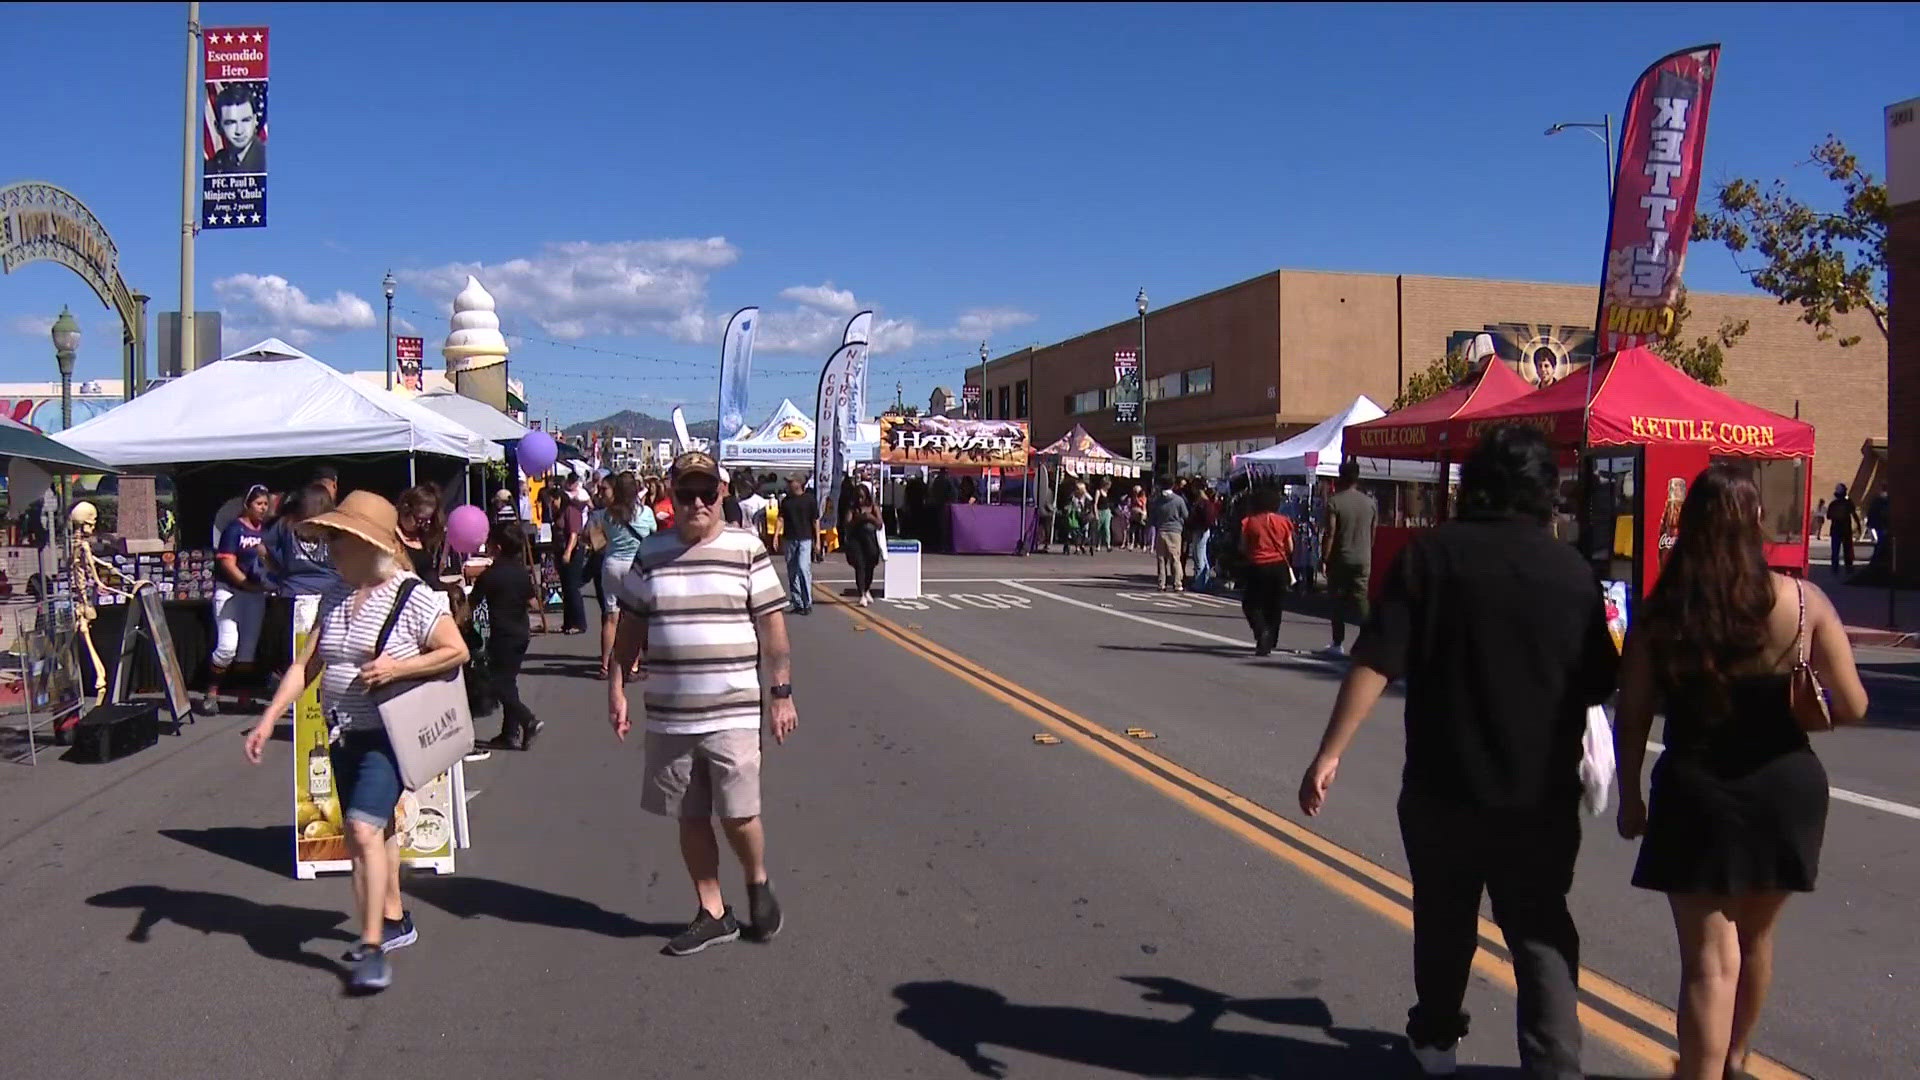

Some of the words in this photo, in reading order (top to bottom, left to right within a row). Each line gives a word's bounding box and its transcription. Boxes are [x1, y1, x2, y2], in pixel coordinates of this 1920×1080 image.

[207, 48, 264, 62] Escondido
[221, 64, 249, 77] Hero
[211, 178, 229, 188] PFC.
[230, 176, 248, 188] Paul
[248, 176, 258, 187] D.
[838, 348, 858, 407] NITRO
[823, 373, 836, 421] COLD
[1360, 427, 1399, 447] KETTLE
[1399, 426, 1427, 444] CORN
[1630, 415, 1717, 442] KETTLE
[1719, 422, 1775, 447] CORN
[820, 435, 831, 483] BREW
[1135, 451, 1153, 463] 25
[417, 707, 457, 749] MELLANO
